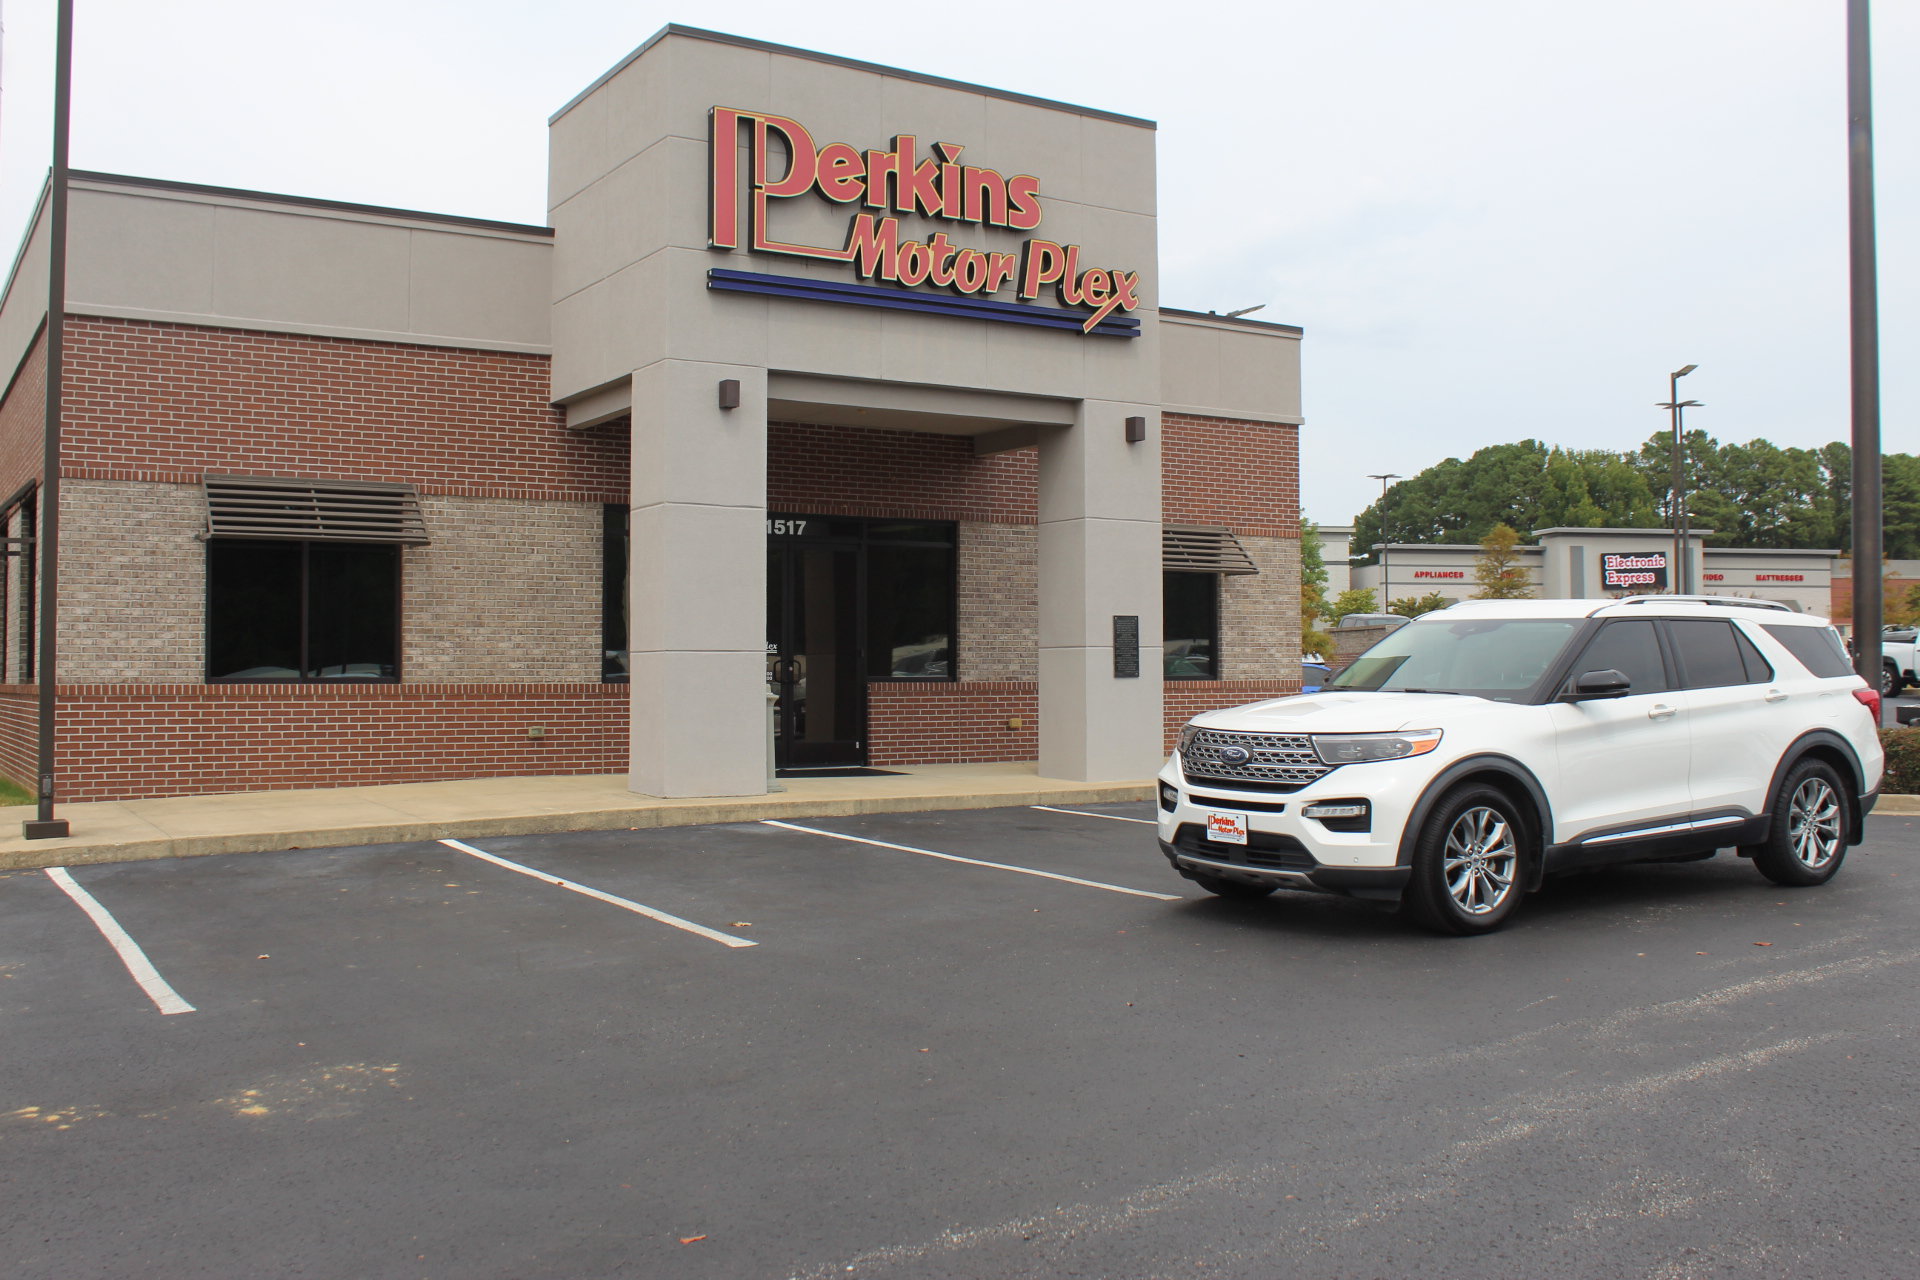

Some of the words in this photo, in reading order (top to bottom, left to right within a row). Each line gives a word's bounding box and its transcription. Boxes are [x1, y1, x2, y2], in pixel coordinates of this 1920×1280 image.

[708, 106, 1043, 249] Perkins
[845, 213, 1016, 294] Motor
[1017, 239, 1140, 333] Plex
[1605, 554, 1665, 569] Electronic
[1414, 571, 1465, 579] APPLIANCES
[1605, 571, 1655, 586] Express
[766, 641, 777, 649] lex
[1208, 815, 1235, 829] Perkins
